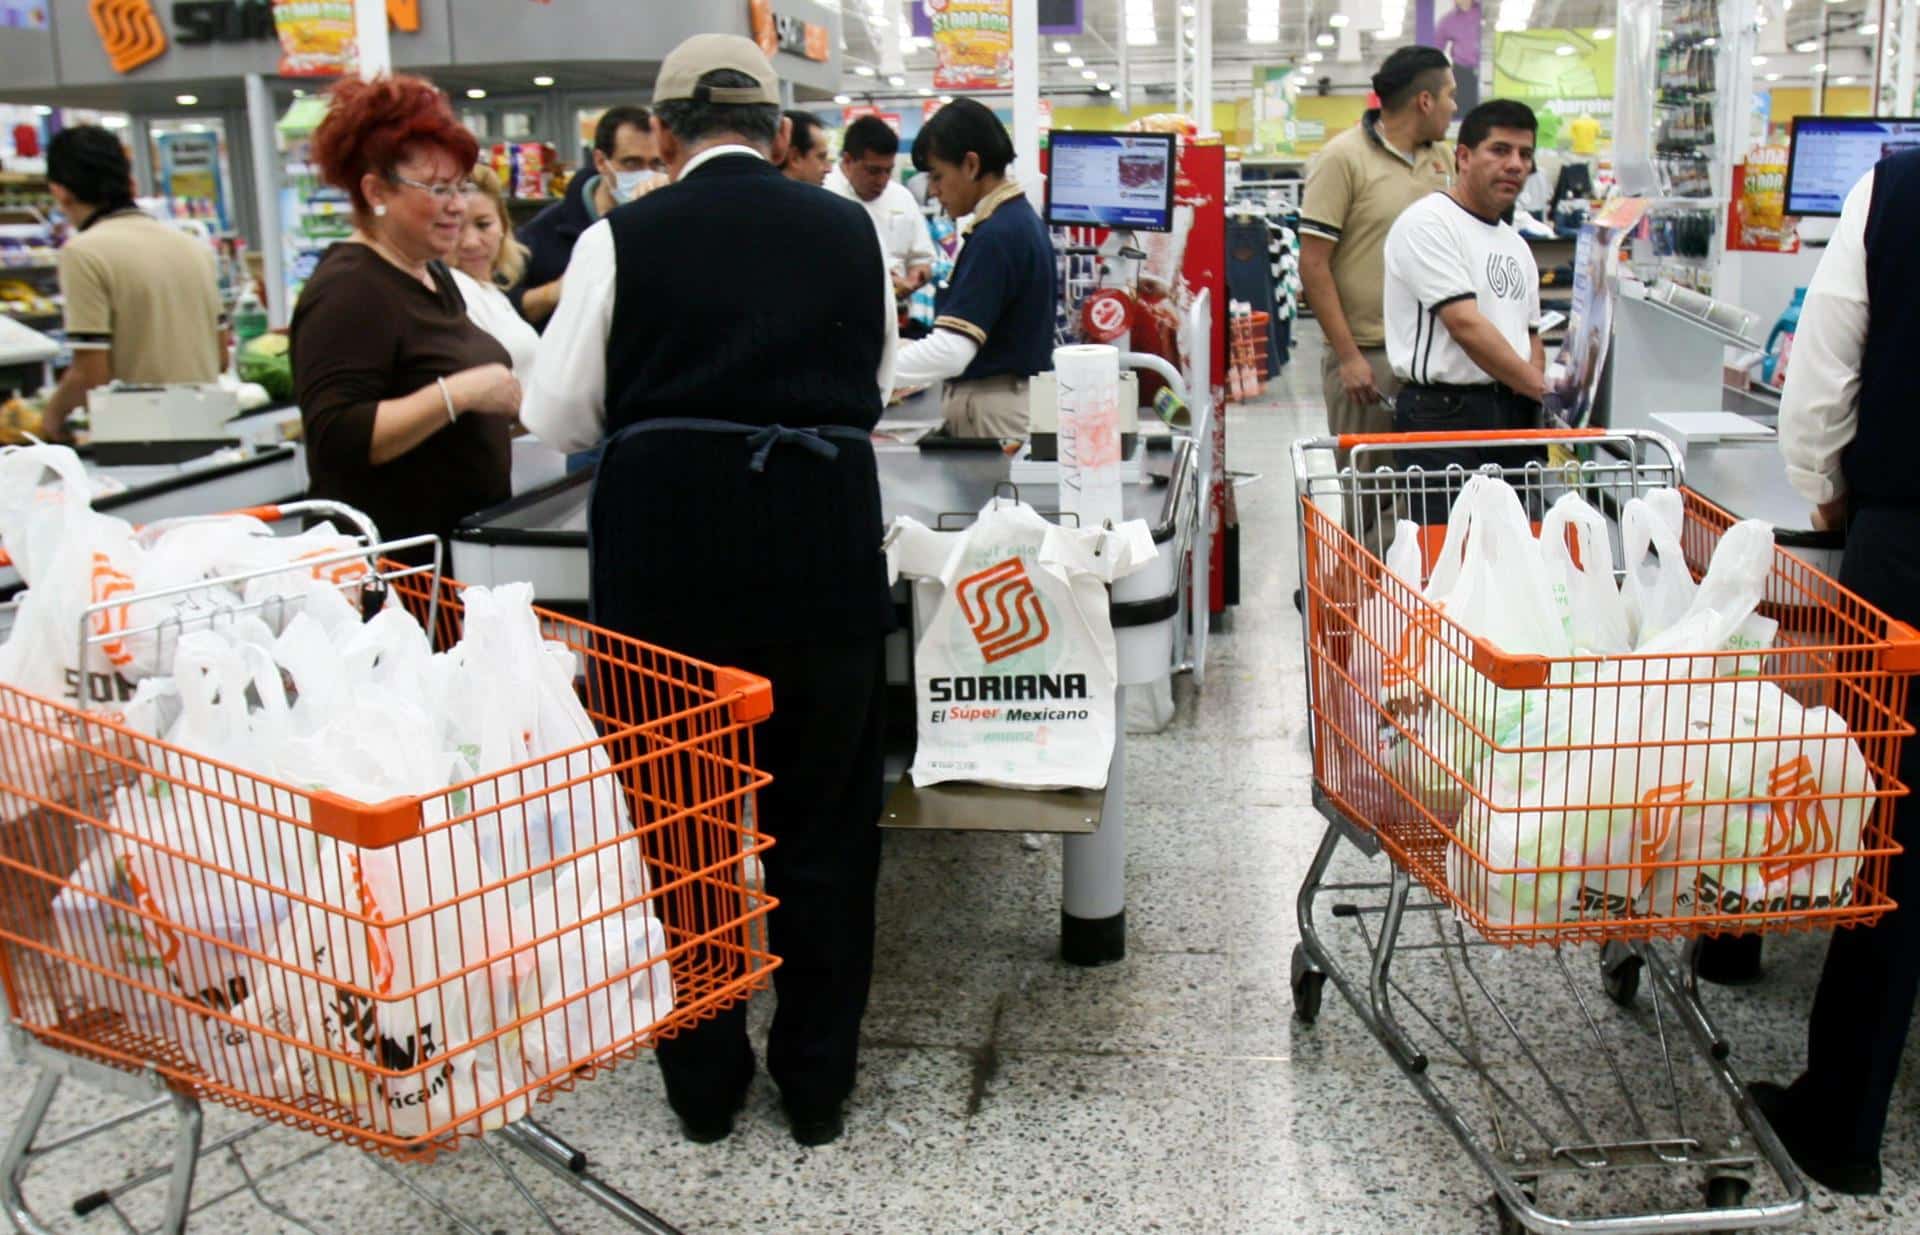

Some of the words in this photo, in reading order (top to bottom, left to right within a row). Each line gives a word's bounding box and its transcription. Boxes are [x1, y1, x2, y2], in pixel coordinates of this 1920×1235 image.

[929, 674, 1088, 702] SORIANA
[930, 711, 946, 723] El
[949, 704, 1001, 721] Súper
[1006, 708, 1089, 721] Mexicano
